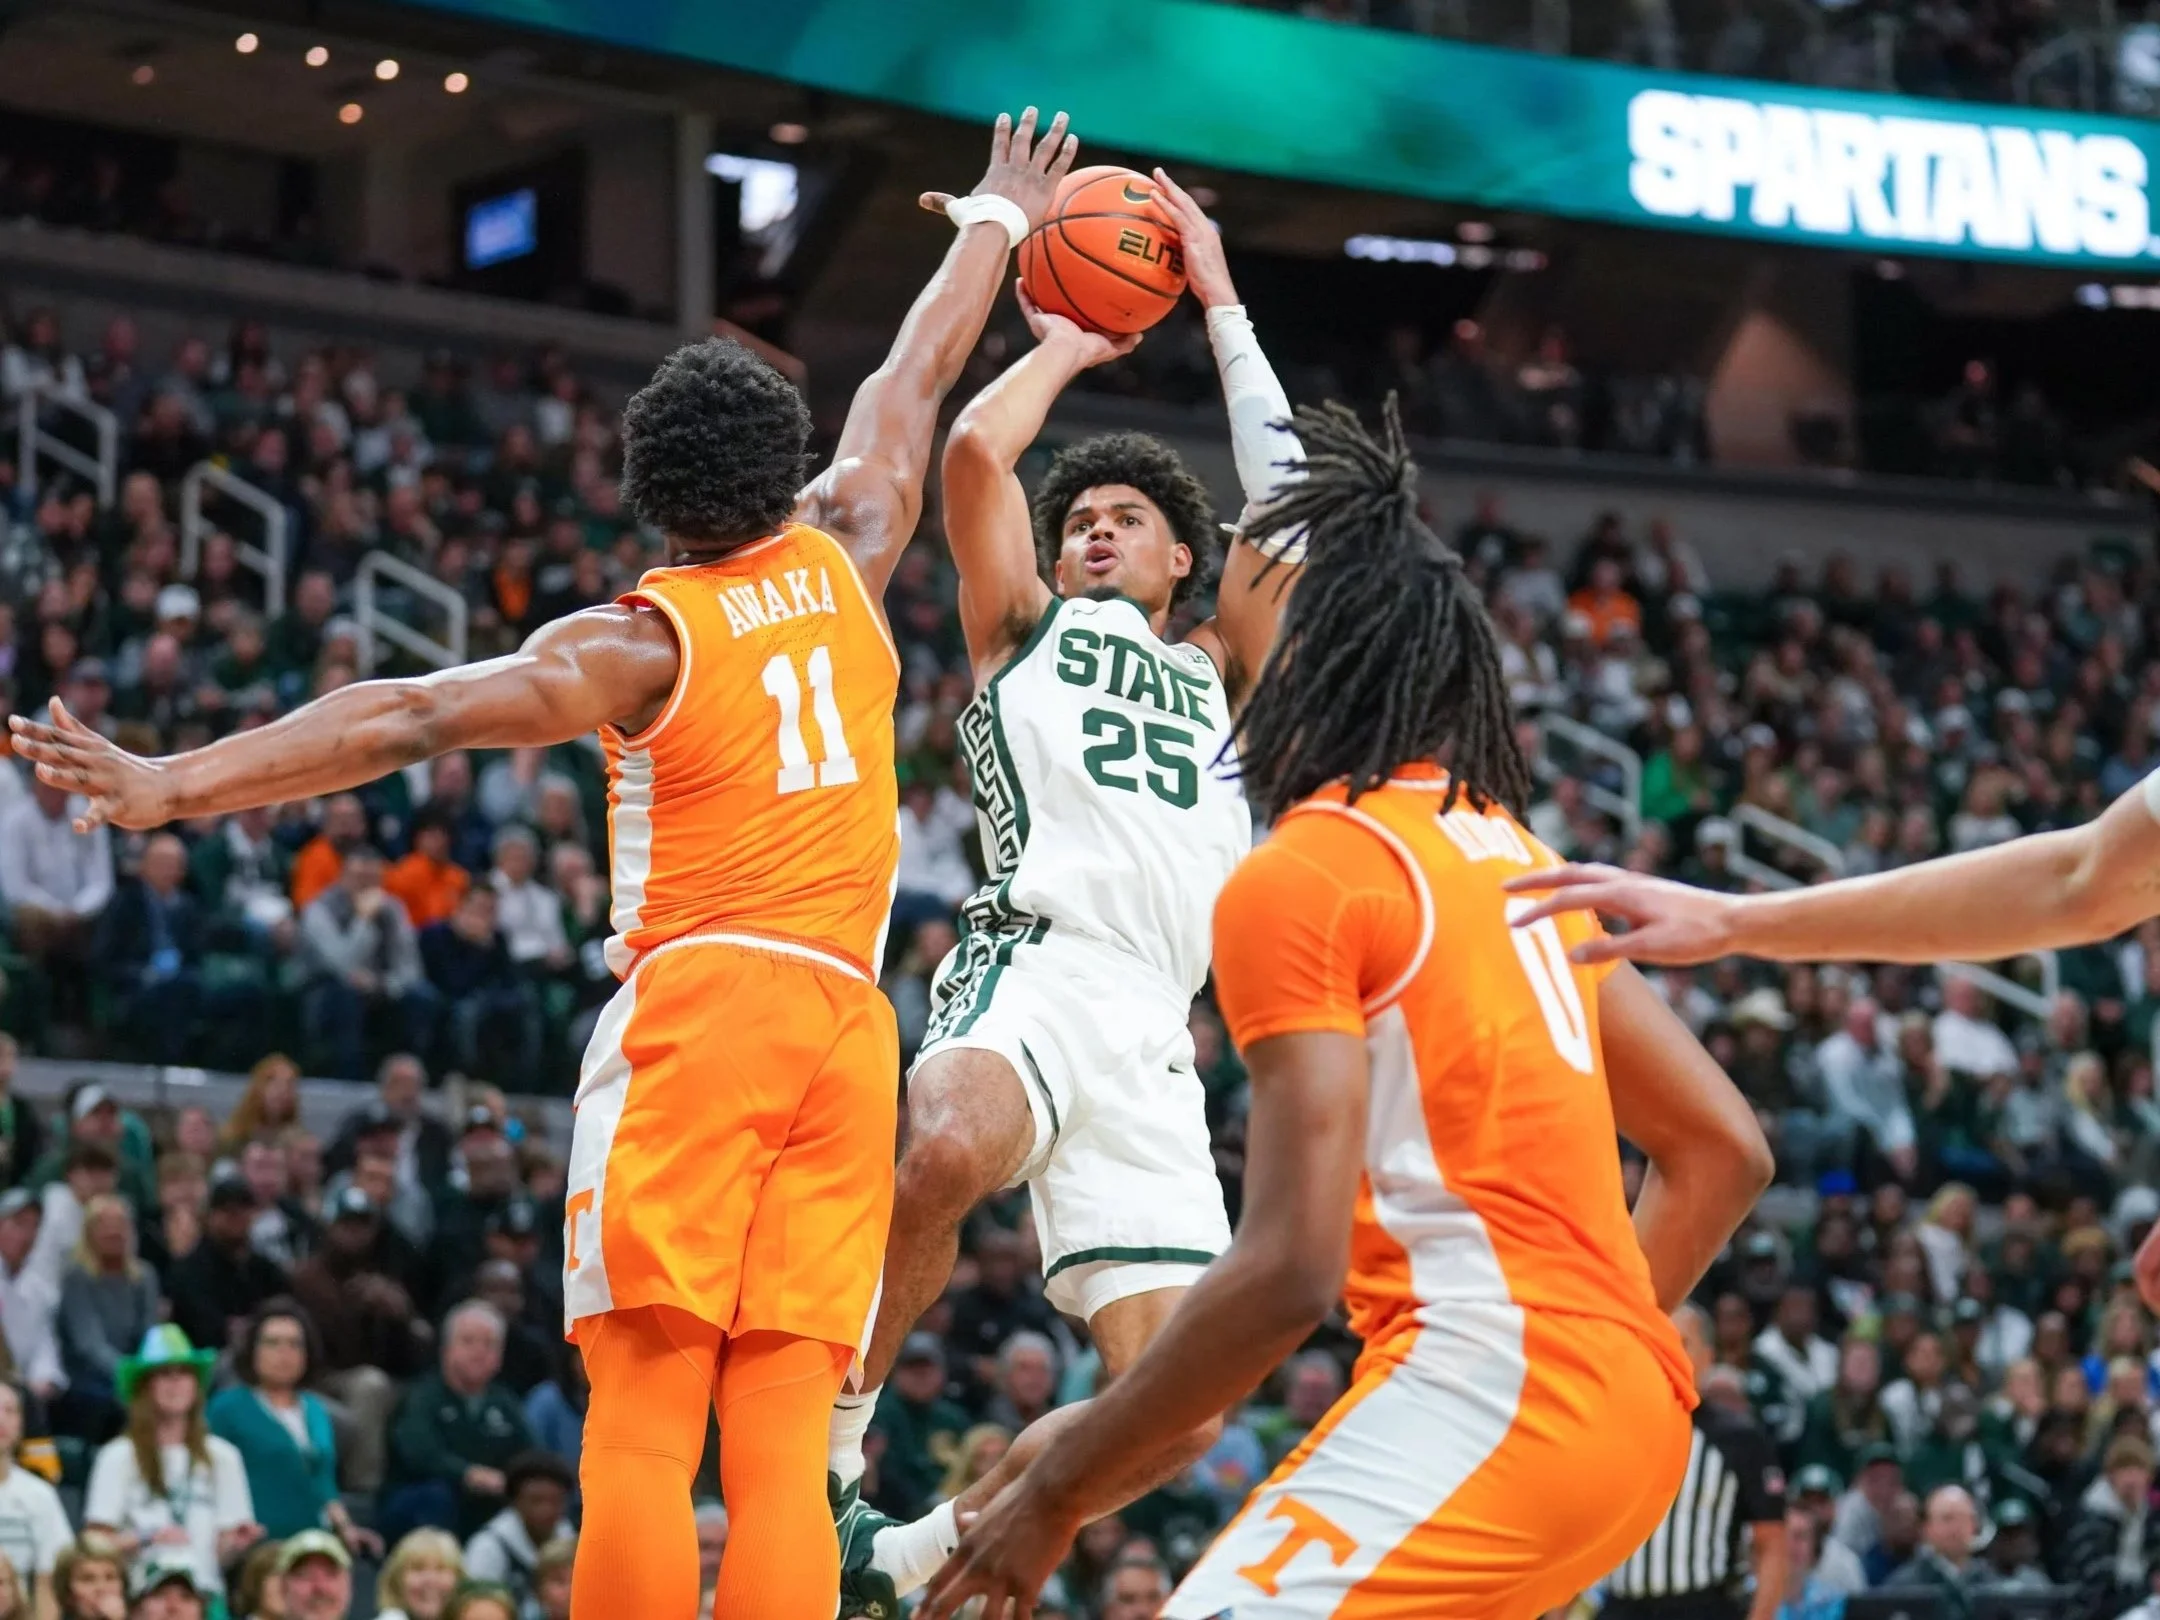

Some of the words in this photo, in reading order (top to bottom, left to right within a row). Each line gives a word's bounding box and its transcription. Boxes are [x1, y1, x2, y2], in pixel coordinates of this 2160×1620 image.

[1628, 88, 2149, 258] SPARTANS
[717, 566, 837, 640] AWAKA
[761, 645, 859, 795] 11
[1057, 628, 1216, 732] STATE
[1082, 707, 1199, 810] 25
[1505, 896, 1595, 1076] 0
[1235, 1493, 1361, 1598] T
